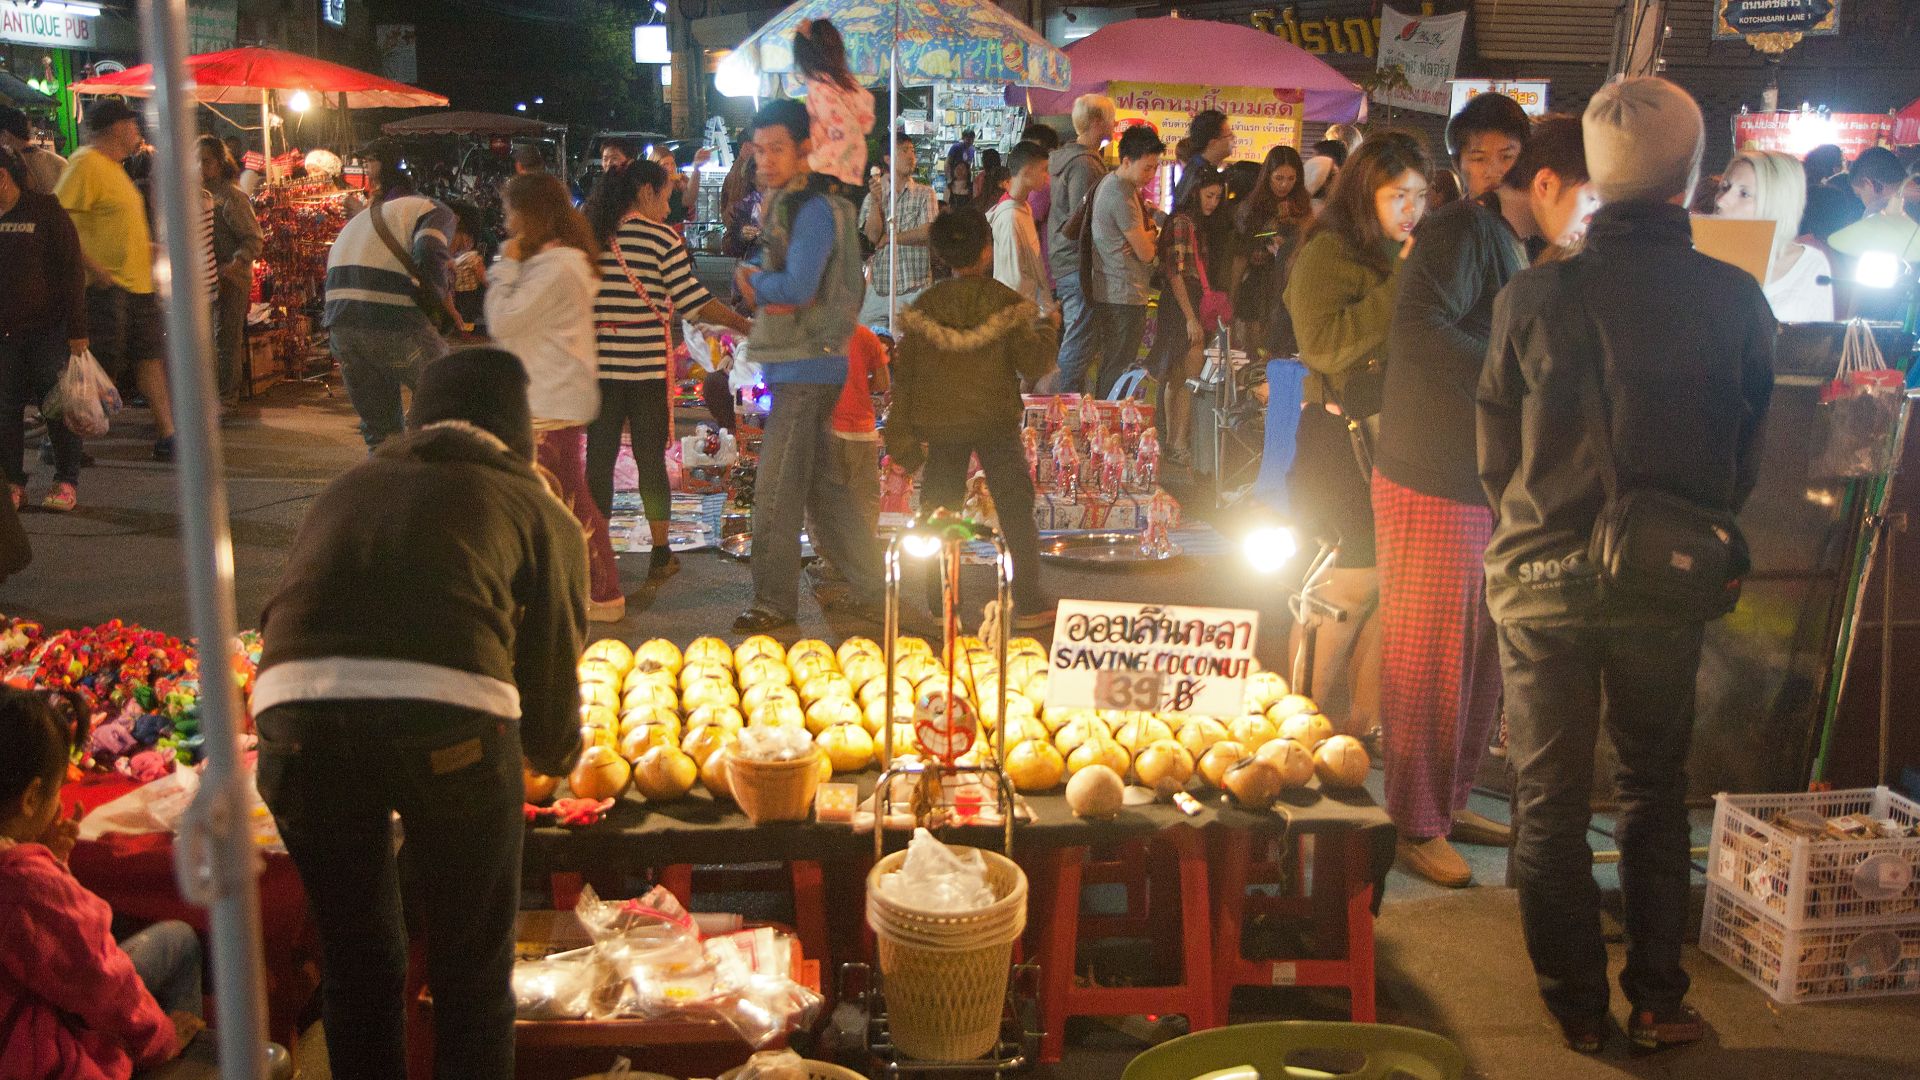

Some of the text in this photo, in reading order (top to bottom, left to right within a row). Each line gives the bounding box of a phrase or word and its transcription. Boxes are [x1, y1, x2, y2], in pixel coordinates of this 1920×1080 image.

[3, 10, 89, 40] ANTIQUE PUB
[1739, 16, 1785, 24] KOTCHASARN
[1787, 13, 1805, 21] LANE
[1055, 647, 1250, 679] SAVING COCONUT
